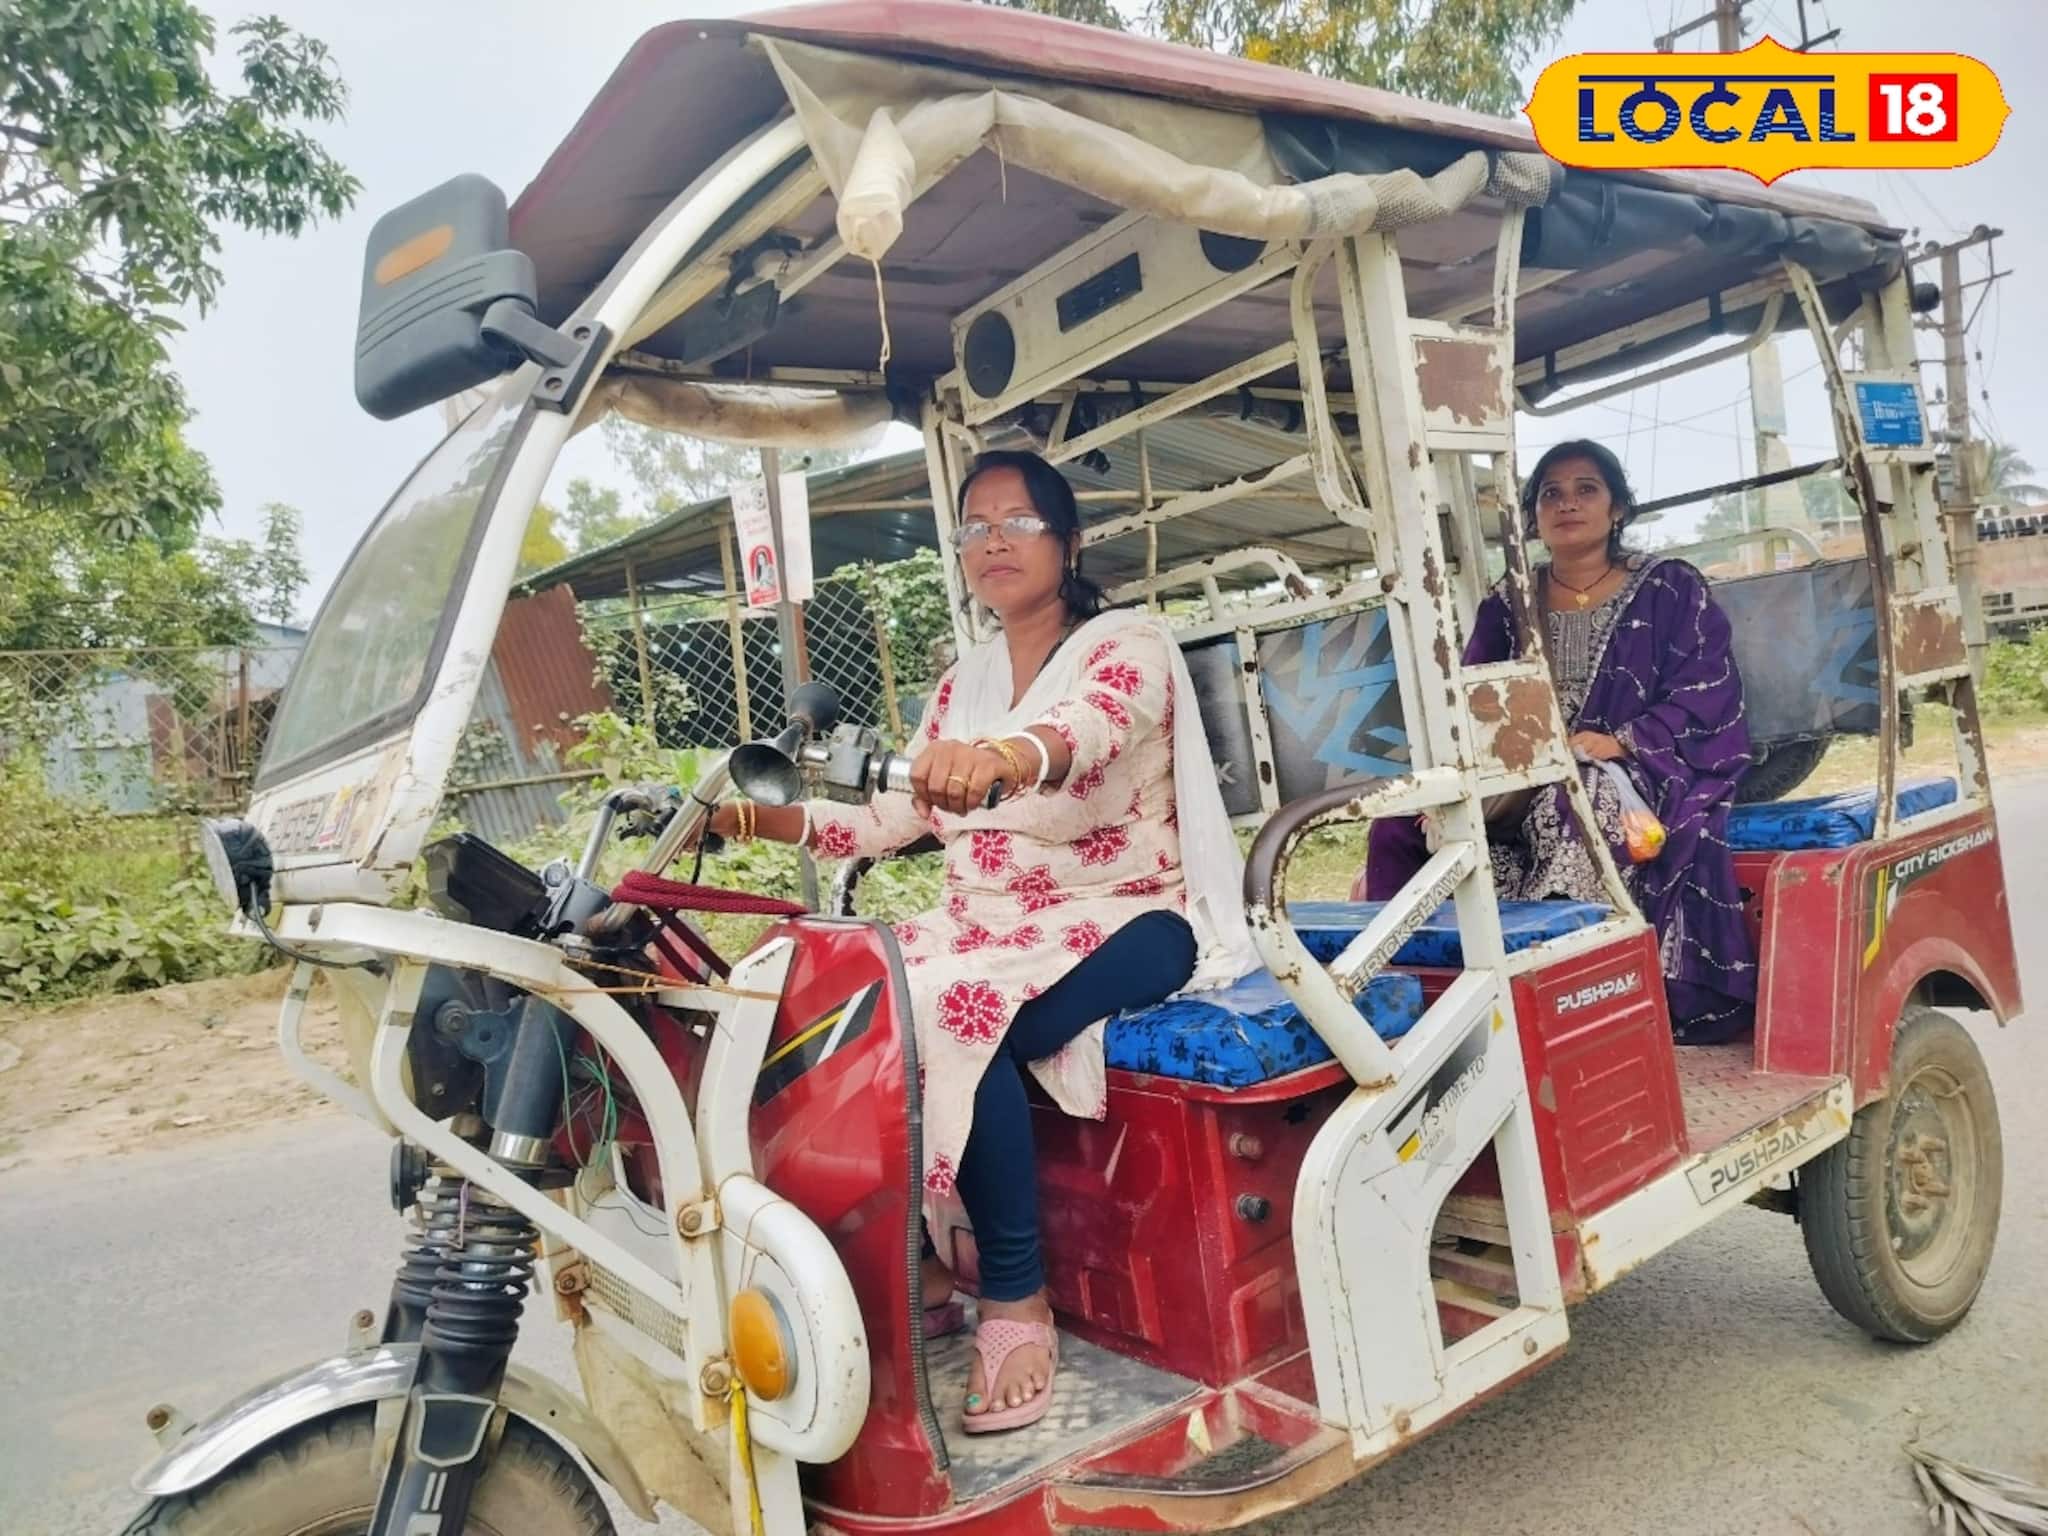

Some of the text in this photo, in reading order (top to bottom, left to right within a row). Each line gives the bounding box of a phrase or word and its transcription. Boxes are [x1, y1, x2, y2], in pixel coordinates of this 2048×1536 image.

[1895, 853, 1926, 878] CITY
[1557, 971, 1637, 1015] PUSHPAK
[1440, 1071, 1470, 1113] TIME
[1469, 1055, 1486, 1081] TO
